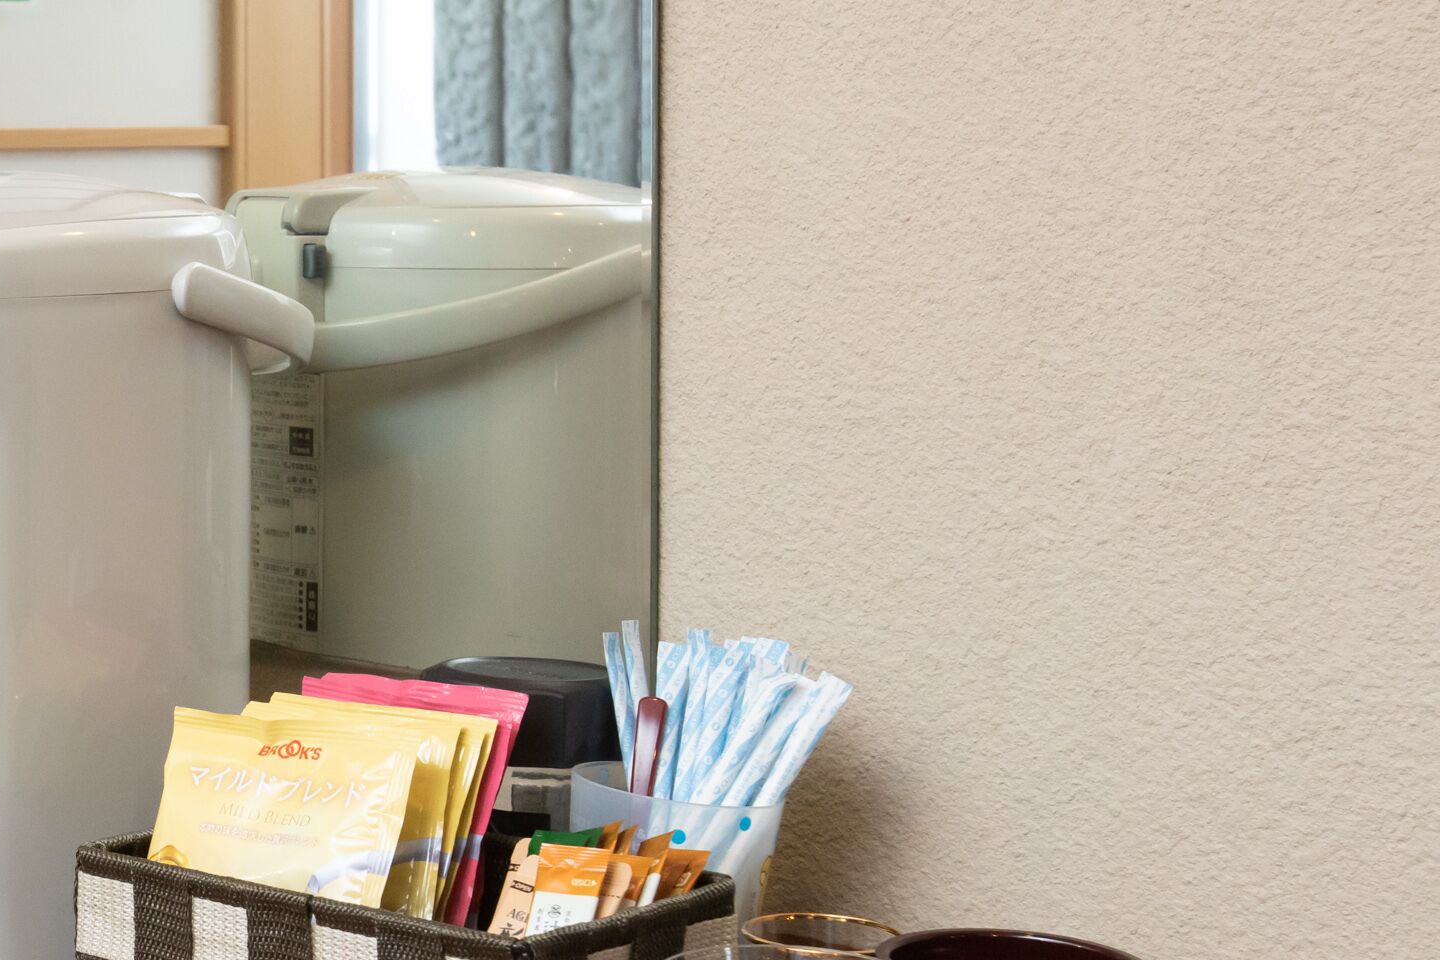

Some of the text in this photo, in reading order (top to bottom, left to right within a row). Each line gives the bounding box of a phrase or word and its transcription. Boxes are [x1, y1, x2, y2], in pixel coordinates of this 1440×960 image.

[191, 765, 366, 808] マイルドブレンド
